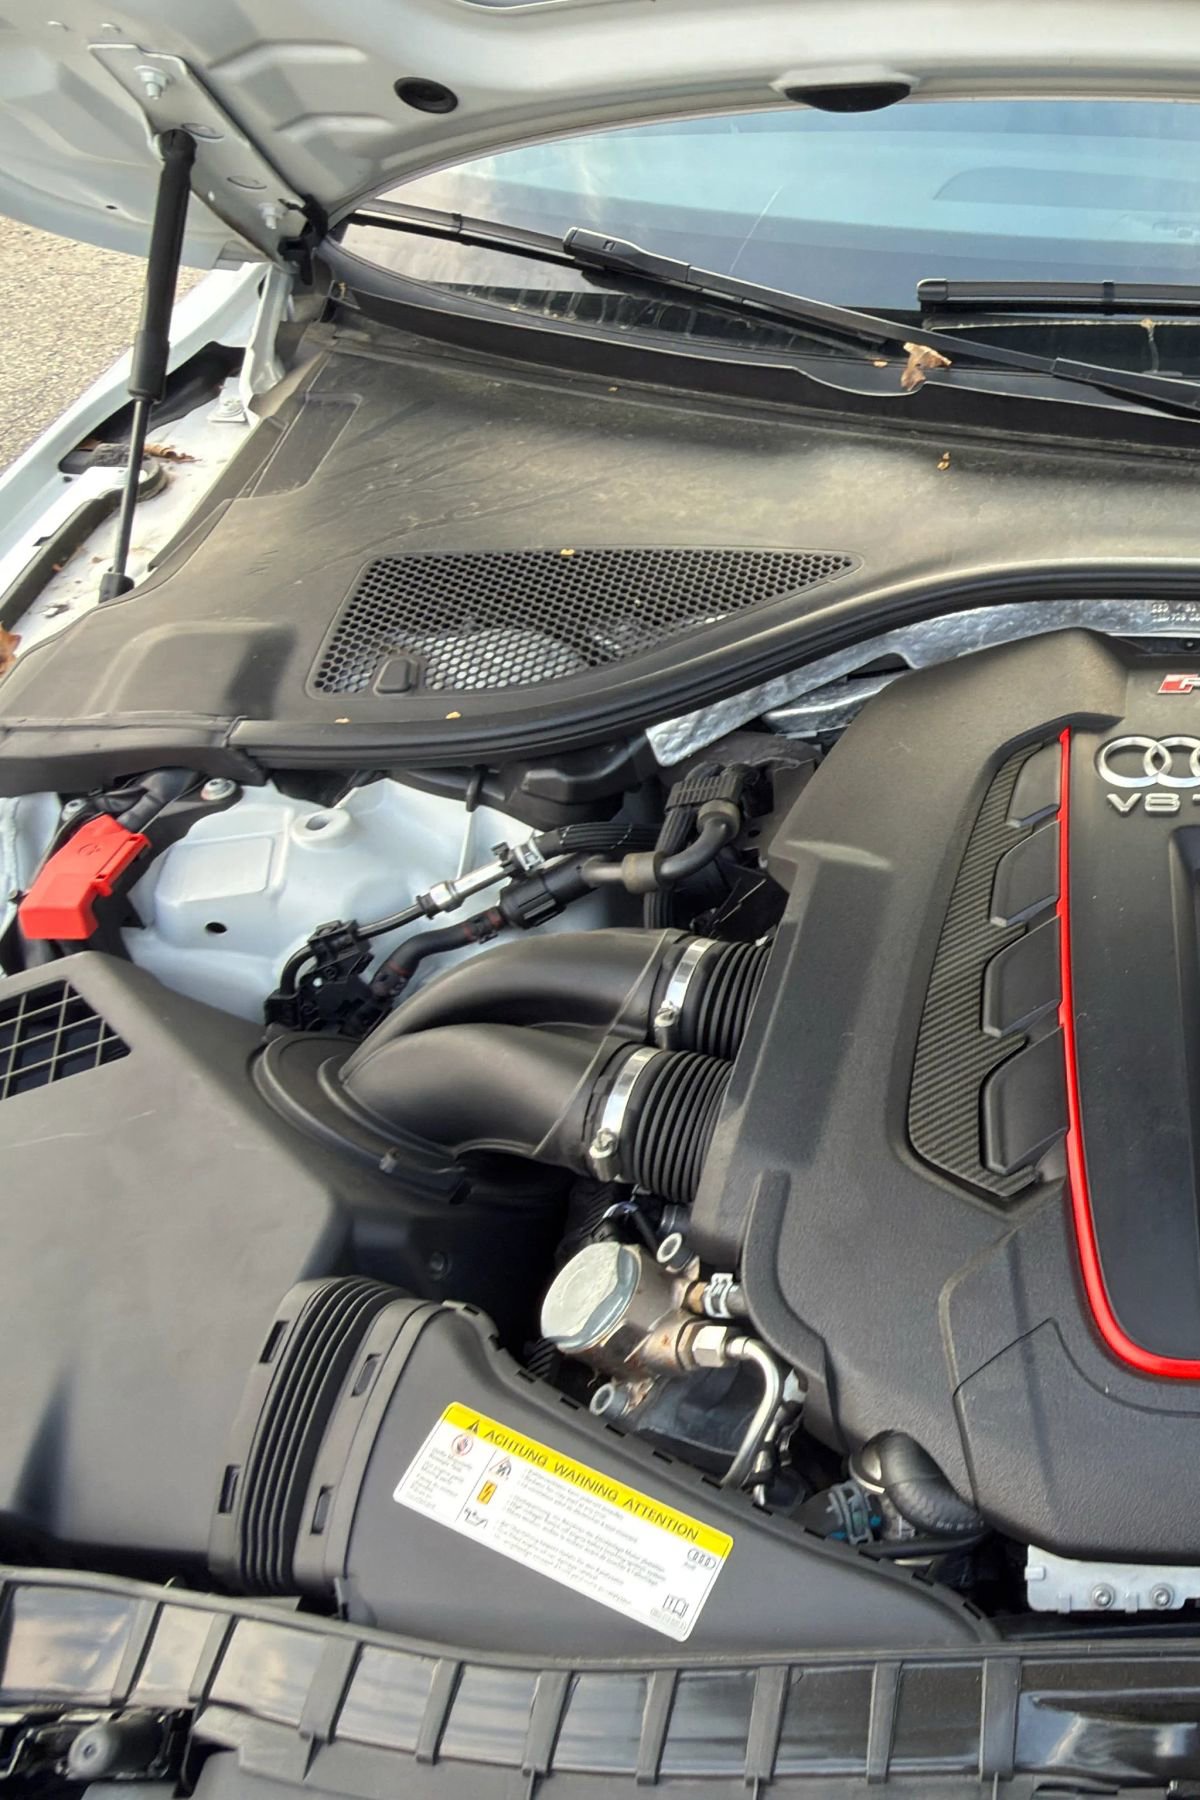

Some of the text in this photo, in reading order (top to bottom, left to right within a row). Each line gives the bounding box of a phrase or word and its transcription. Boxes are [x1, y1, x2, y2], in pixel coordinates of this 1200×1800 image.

[1106, 793, 1182, 815] V8
[484, 1430, 548, 1467] ACHTUNG
[554, 1461, 619, 1502] WARNING
[623, 1498, 700, 1541] ATTENTION
